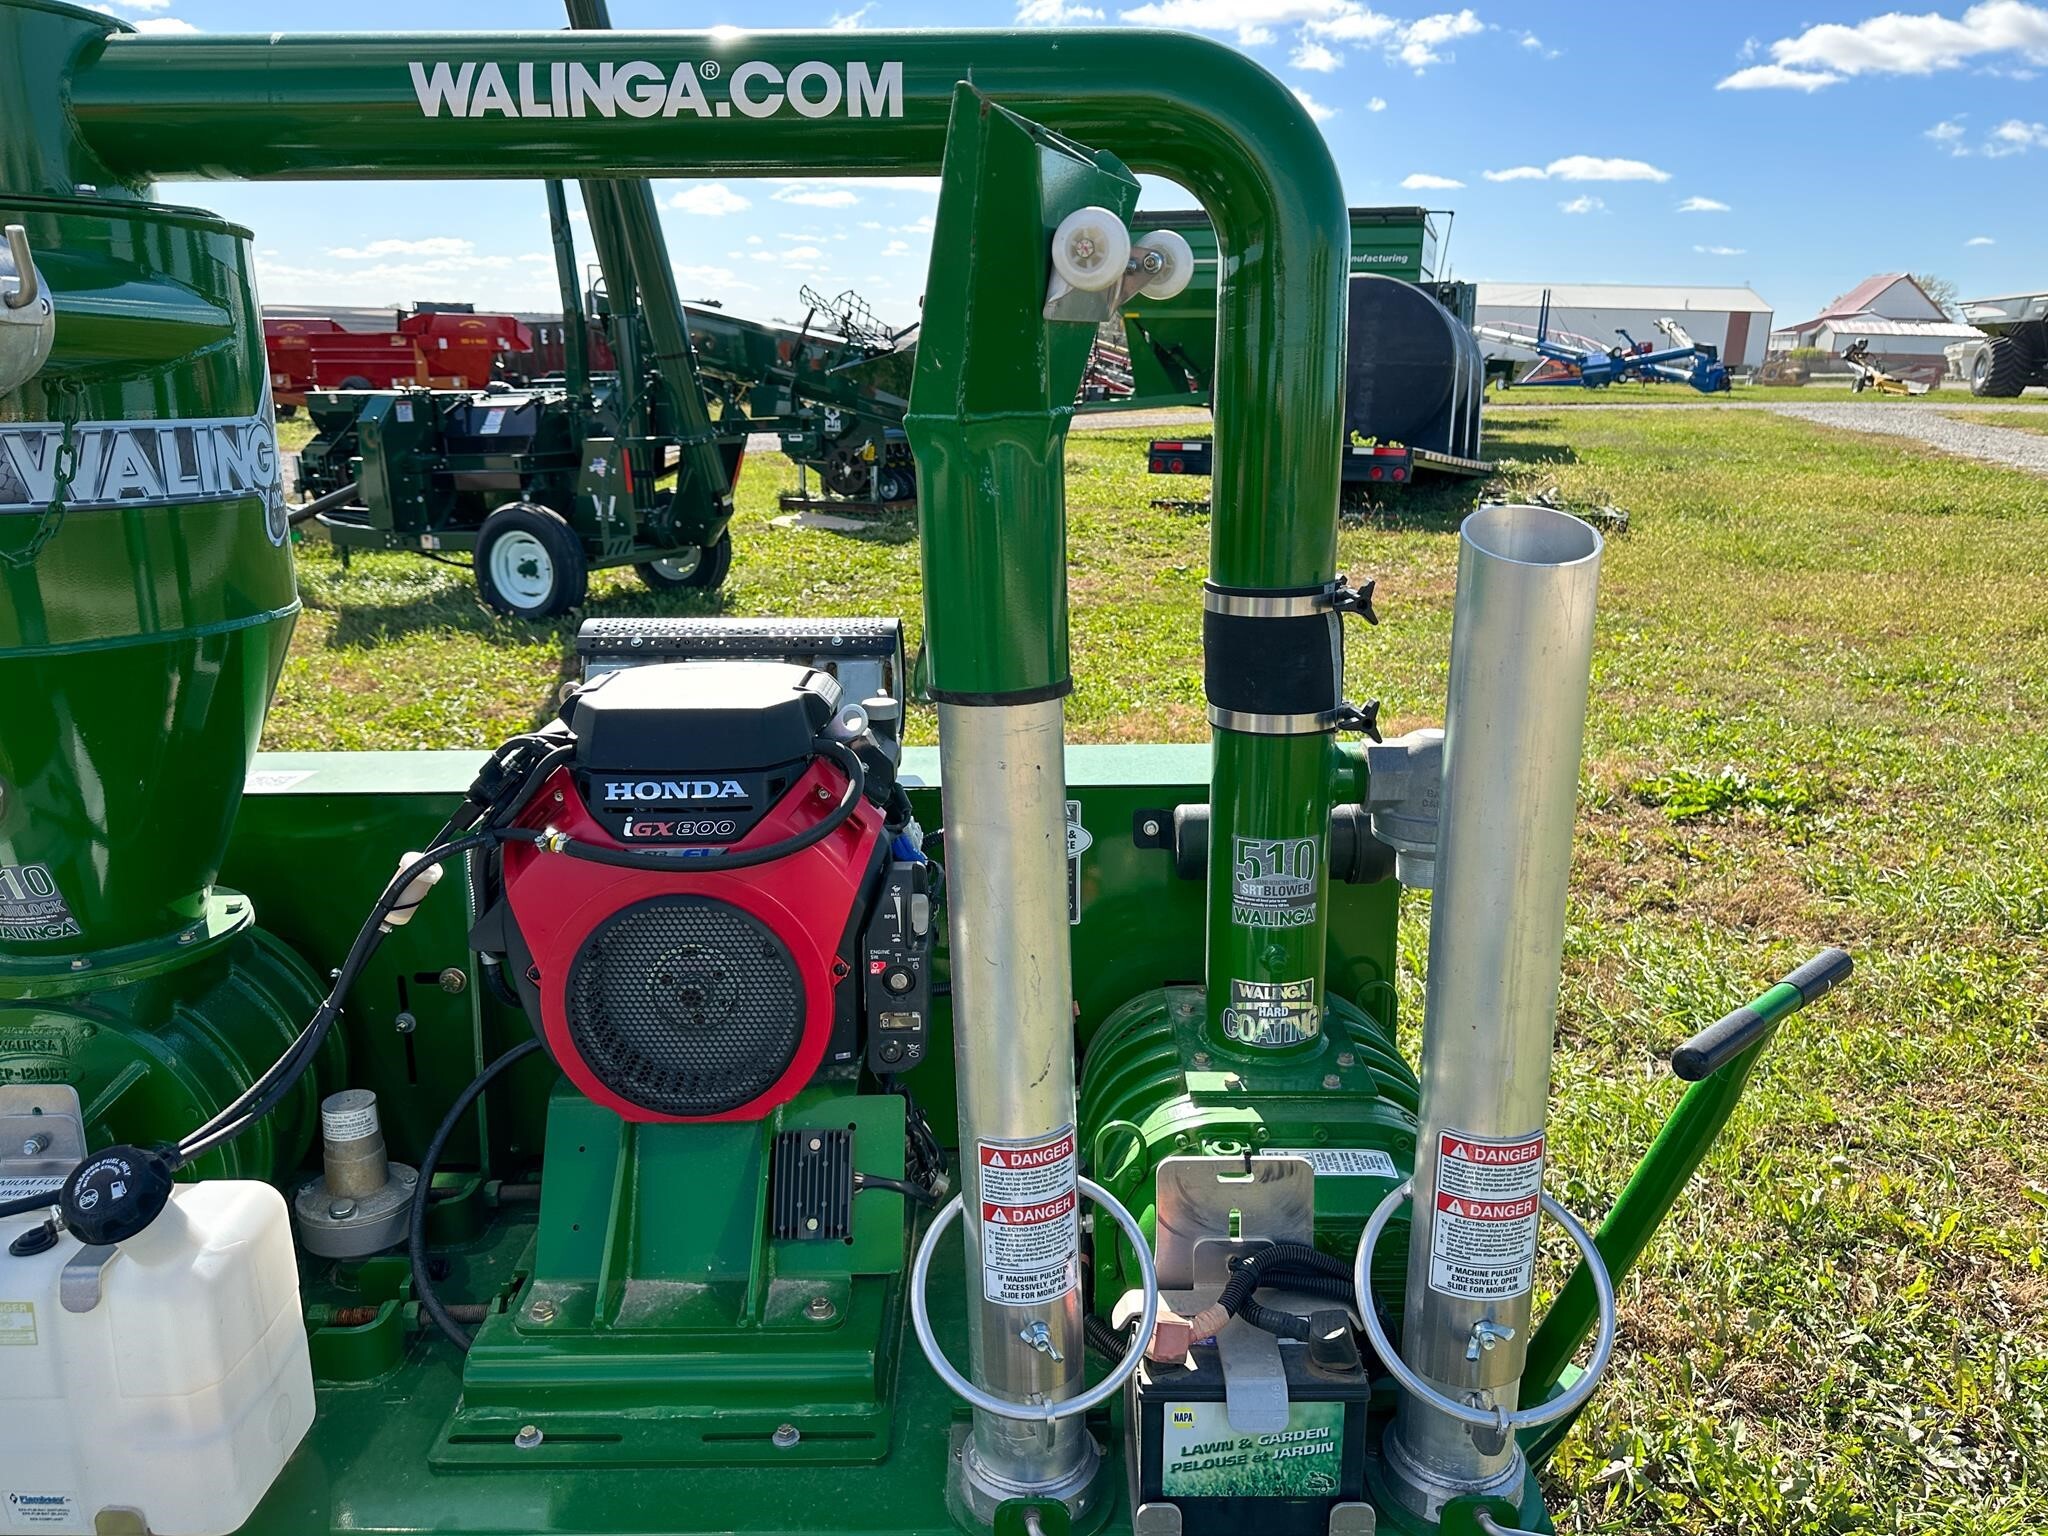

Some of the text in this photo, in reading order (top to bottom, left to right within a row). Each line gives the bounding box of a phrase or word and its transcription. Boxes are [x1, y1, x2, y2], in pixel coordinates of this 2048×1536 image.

[605, 781, 749, 800] HONDA
[1236, 839, 1315, 882] 510
[1258, 1007, 1289, 1017] HARD
[1223, 1005, 1320, 1044] COATING
[1011, 1142, 1069, 1166] DANGER
[1475, 1145, 1537, 1162] DANGER
[1013, 1198, 1070, 1222] DANGER
[1470, 1201, 1532, 1217] DANGER
[1455, 1267, 1489, 1277] MACHINE
[1492, 1266, 1522, 1277] PULSATES
[1003, 1275, 1065, 1291] EXCESSIVELY, OPEN
[1447, 1282, 1467, 1291] SLIDE
[1470, 1285, 1484, 1293] FOR
[1451, 1274, 1517, 1286] EXCESSIVELY, OPEN
[1000, 1291, 1019, 1299] SLIDE
[1037, 1287, 1056, 1297] MORE
[1174, 1413, 1193, 1422] NAPA
[1181, 1427, 1330, 1457] LAWN & GARDEN
[1170, 1442, 1335, 1473] PELOUSE et JARDIN
